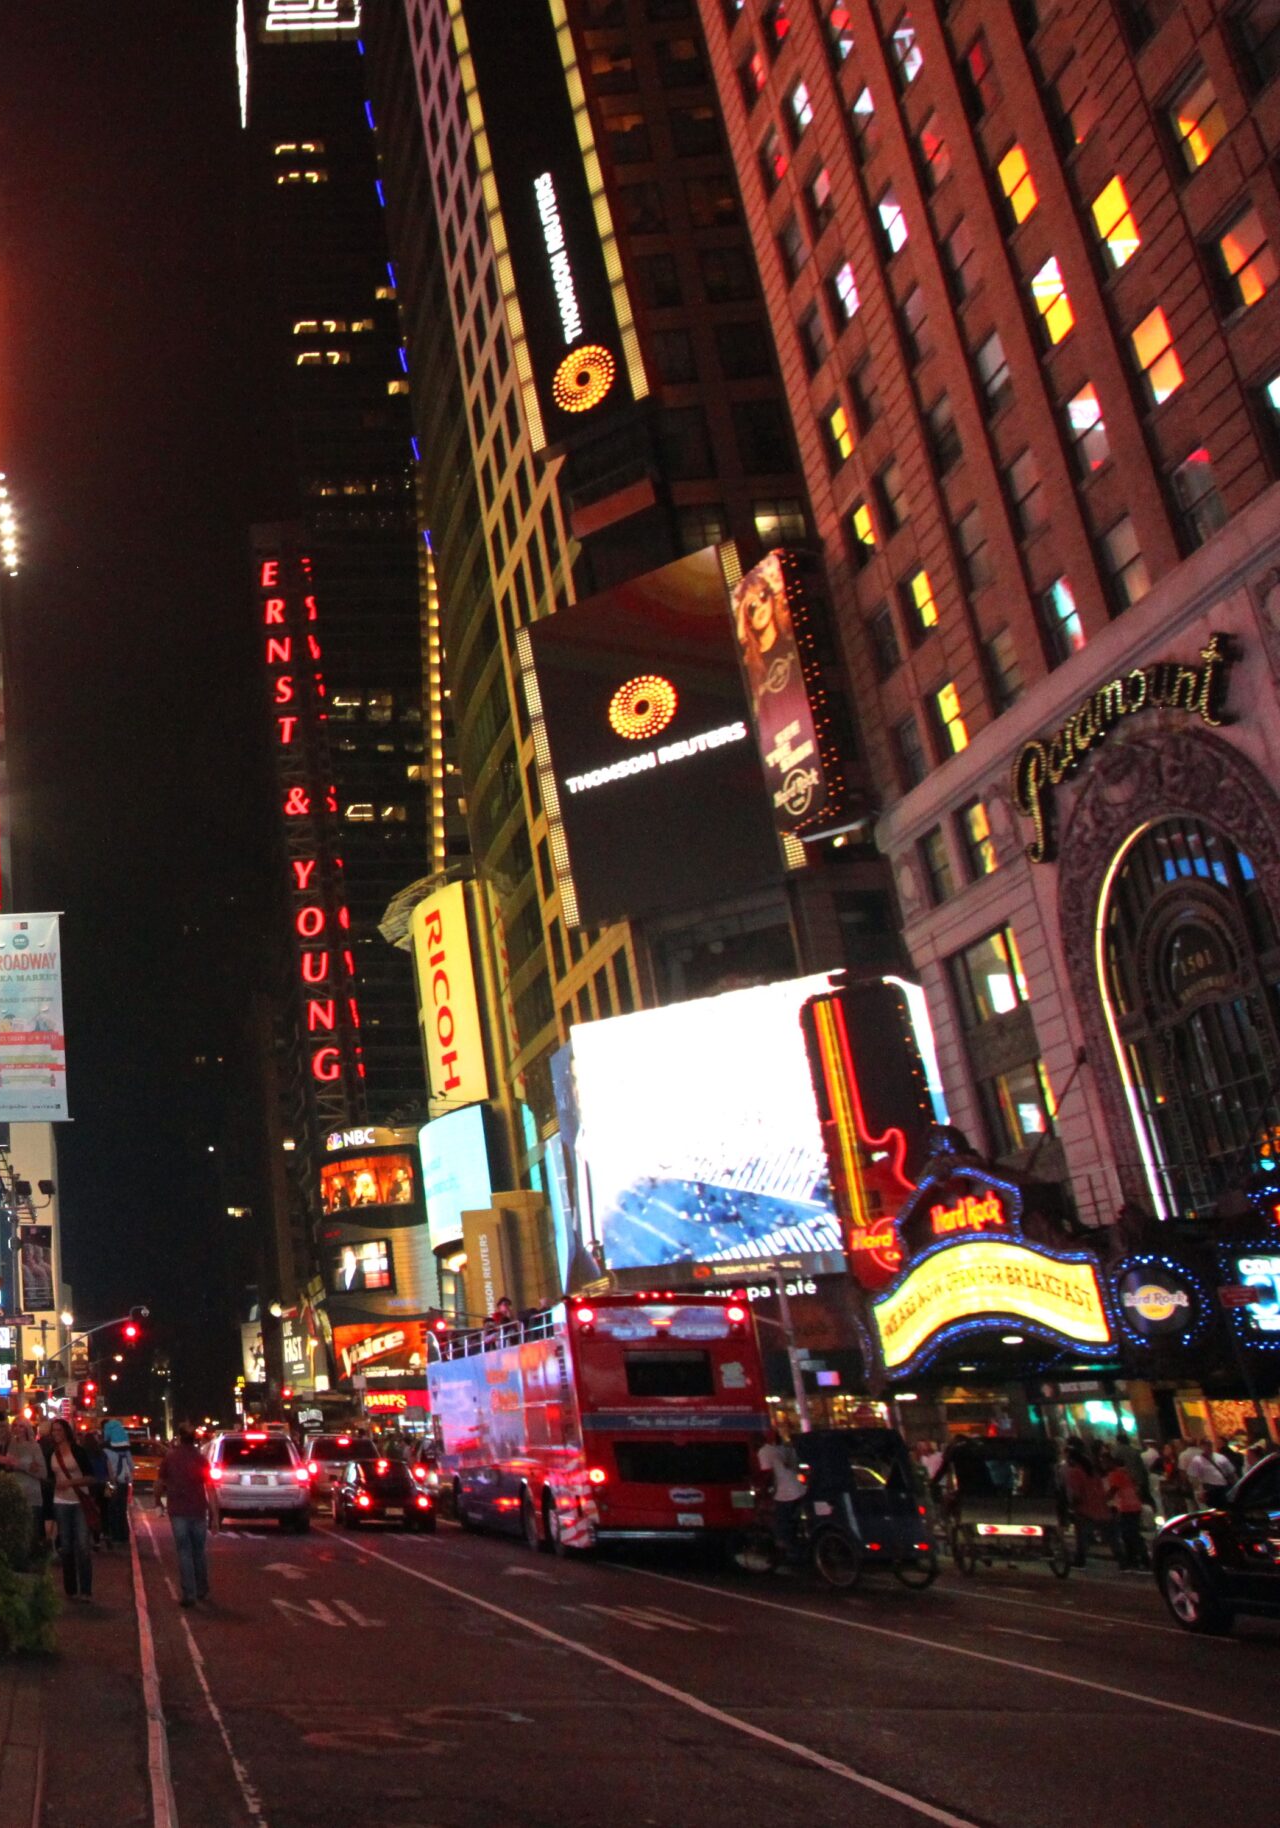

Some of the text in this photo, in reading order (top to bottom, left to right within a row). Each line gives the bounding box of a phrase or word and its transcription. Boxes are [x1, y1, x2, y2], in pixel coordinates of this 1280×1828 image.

[534, 172, 583, 344] THOMSON REUTERS
[565, 720, 747, 794] THOMSON REUTERS
[1012, 634, 1226, 864] Paramount
[261, 560, 299, 744] ERNST
[293, 859, 342, 1081] YOUNG
[16, 973, 59, 982] MARKET
[424, 909, 462, 1092] RICOH
[343, 1128, 375, 1147] NBC
[478, 1233, 492, 1279] REUTERS
[851, 1227, 895, 1250] Hard
[1004, 1265, 1093, 1312] BREAKFAST
[1123, 1290, 1190, 1308] Hard Rock
[283, 1336, 303, 1364] FAST
[341, 1330, 405, 1378] Voice
